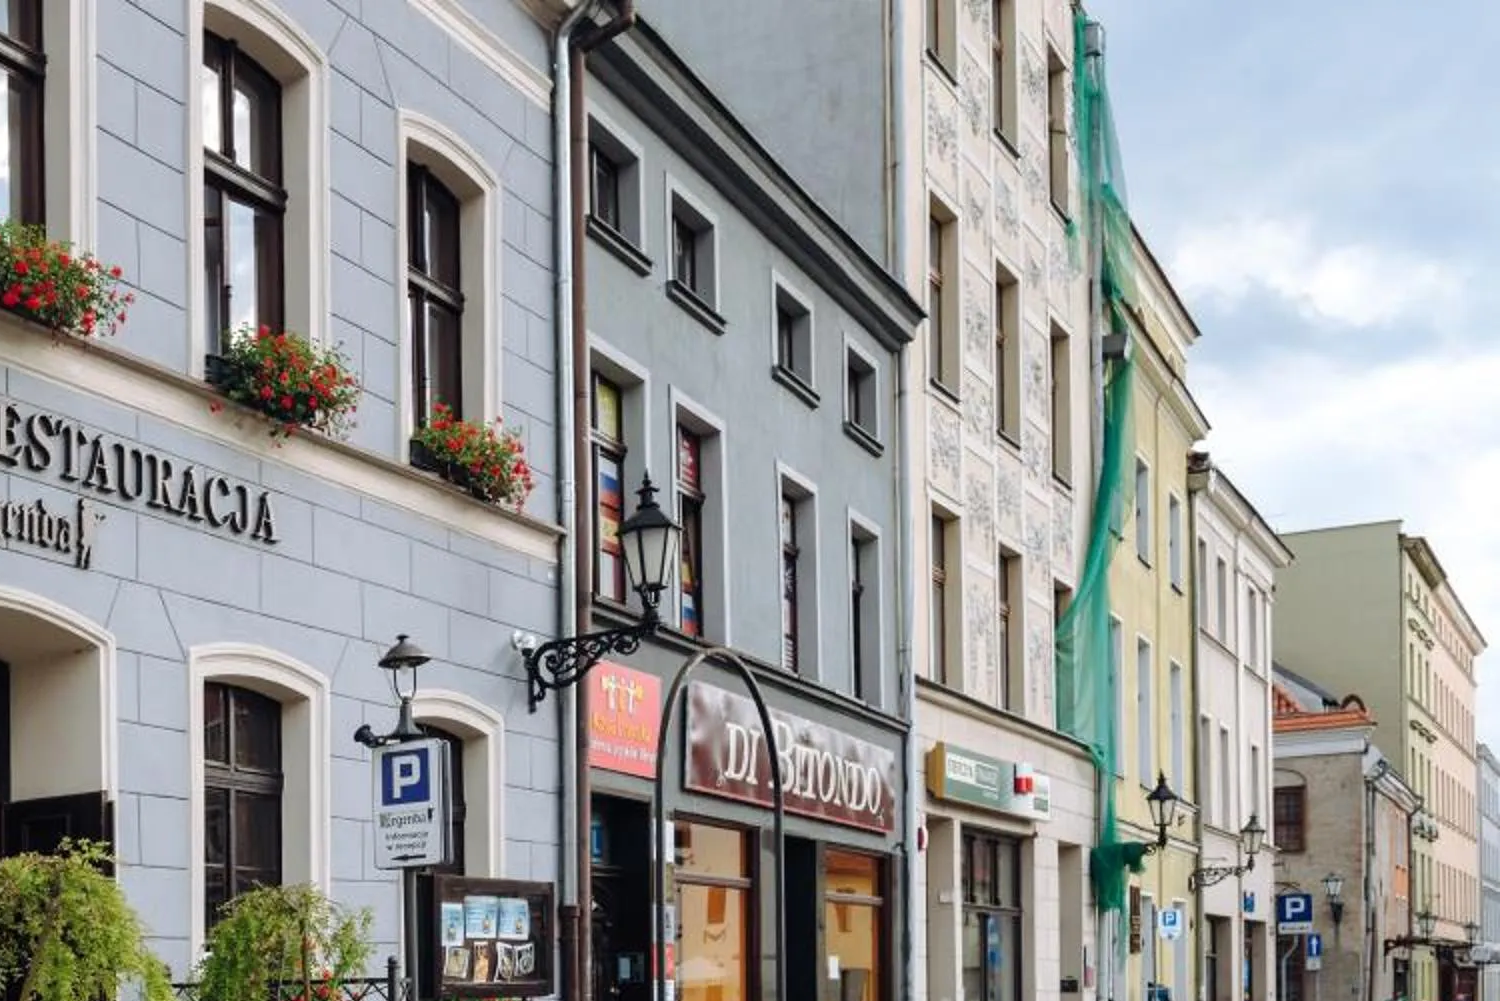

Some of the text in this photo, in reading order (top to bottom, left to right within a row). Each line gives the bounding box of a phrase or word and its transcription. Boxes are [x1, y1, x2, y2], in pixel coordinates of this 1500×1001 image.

[724, 722, 758, 785] DI
[392, 754, 420, 799] P
[1165, 913, 1174, 925] P
[1285, 897, 1305, 920] P
